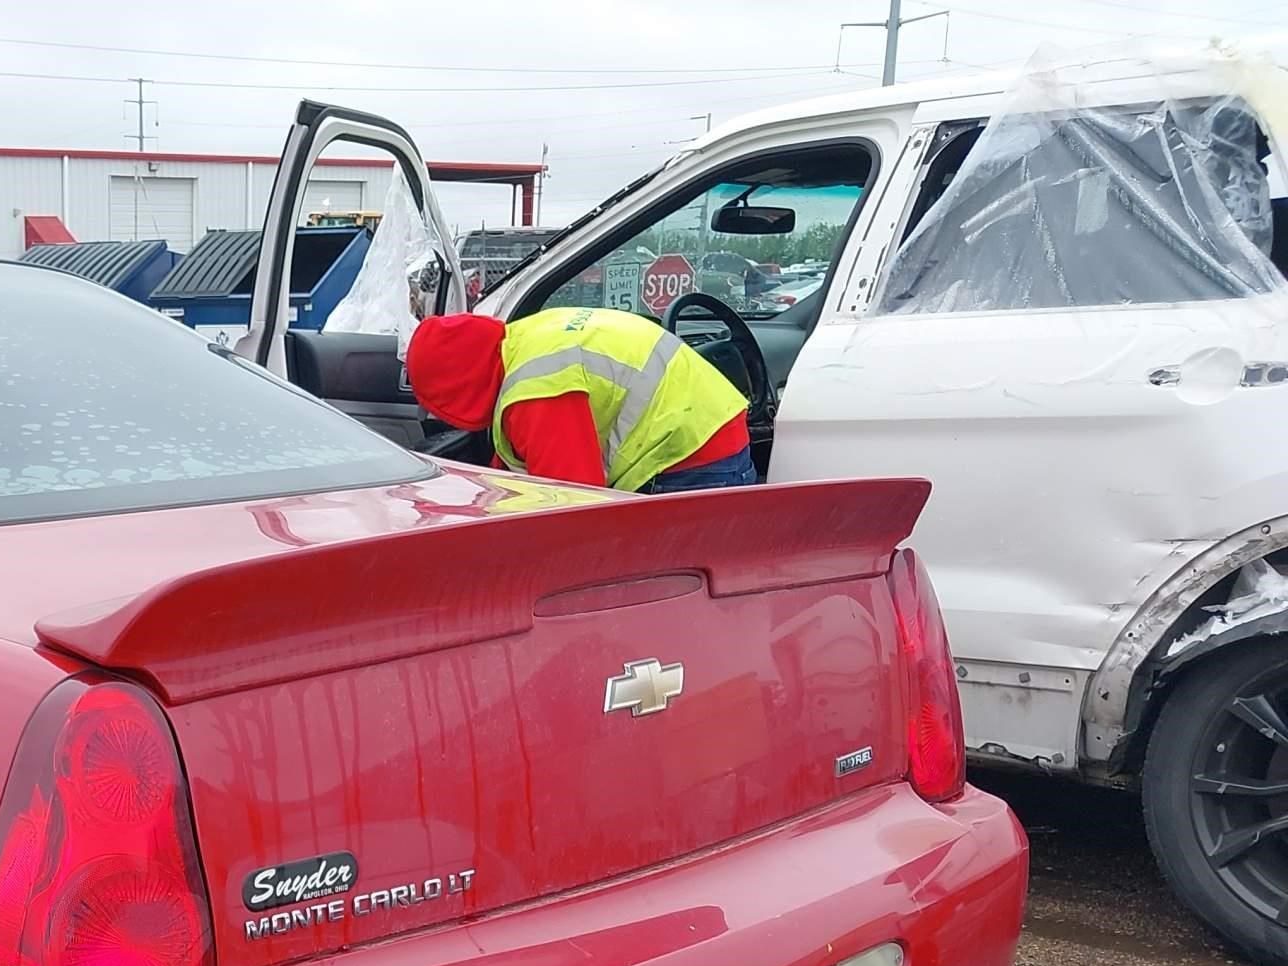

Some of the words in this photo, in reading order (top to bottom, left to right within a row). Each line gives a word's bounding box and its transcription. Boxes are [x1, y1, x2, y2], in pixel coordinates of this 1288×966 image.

[608, 267, 638, 280] SPEED
[610, 280, 633, 291] LIMIT
[646, 274, 691, 297] STOP
[251, 859, 354, 904] Snyder
[244, 899, 346, 941] MONTE
[353, 877, 442, 918] CARLO
[448, 868, 477, 893] LT
